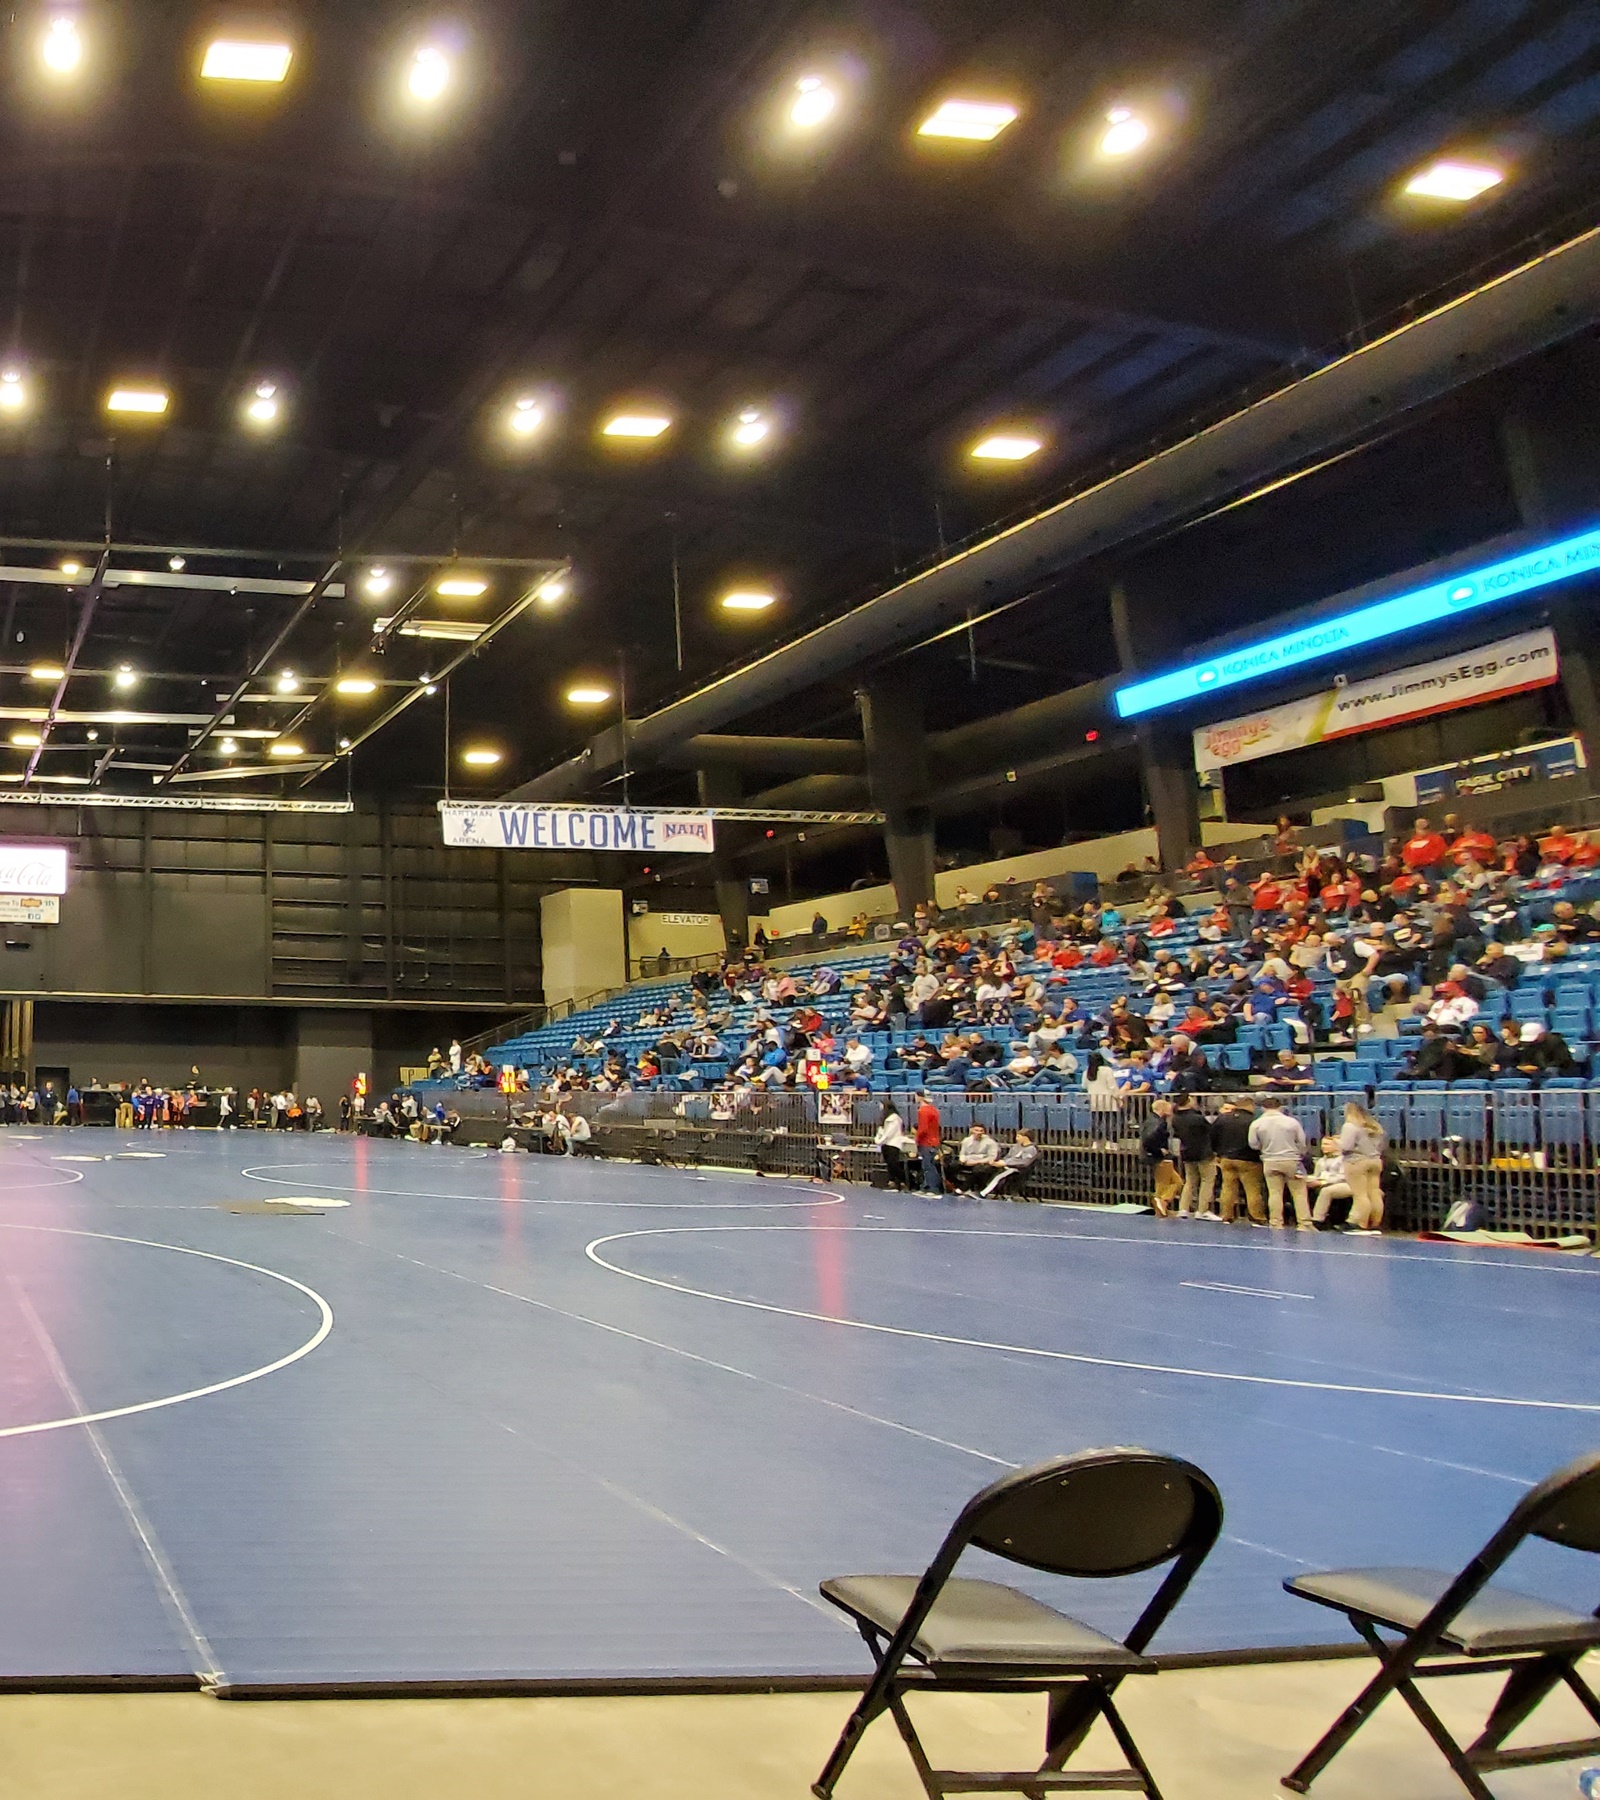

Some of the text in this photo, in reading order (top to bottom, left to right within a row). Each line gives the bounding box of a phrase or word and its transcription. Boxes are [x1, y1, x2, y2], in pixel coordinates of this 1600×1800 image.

[1482, 559, 1562, 593] KONICA
[1222, 626, 1350, 676] KONICA MINOLTA
[1337, 646, 1550, 712] www.JimmysEgg.com
[444, 810, 493, 818] HARTMAN
[499, 811, 707, 849] WELCOME NAIA
[452, 837, 487, 845] ARENA
[661, 914, 709, 924] ELEVATOR
